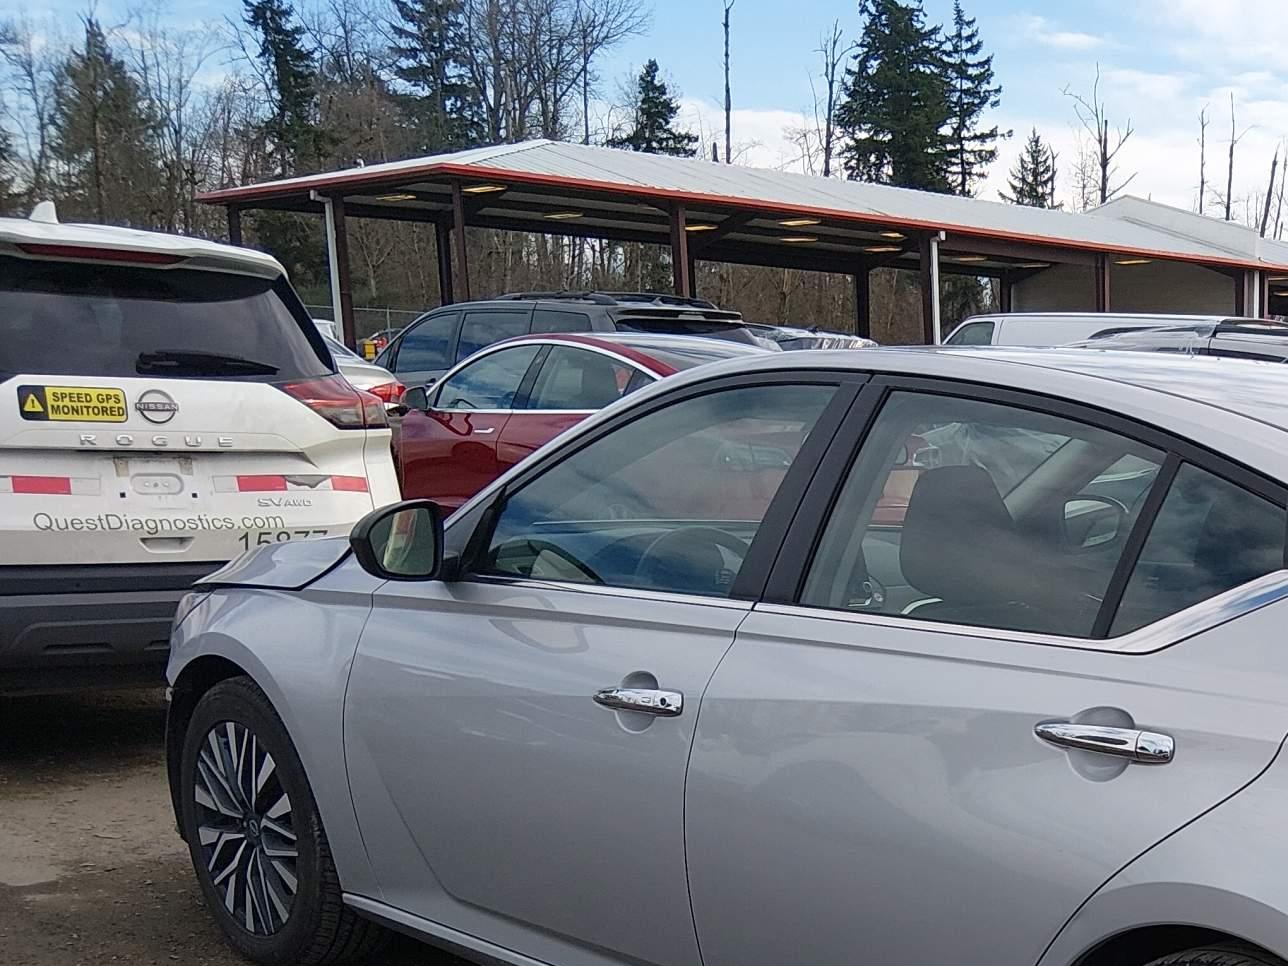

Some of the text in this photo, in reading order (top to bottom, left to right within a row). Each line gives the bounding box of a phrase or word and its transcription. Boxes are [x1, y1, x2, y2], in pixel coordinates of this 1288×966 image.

[52, 391, 121, 405] SPEED GPS
[50, 404, 125, 417] MONITORED
[135, 402, 179, 412] NISSAN
[80, 433, 233, 447] ROGUE
[257, 497, 312, 507] SV AWD
[33, 512, 285, 535] QuestDiagnostics.com
